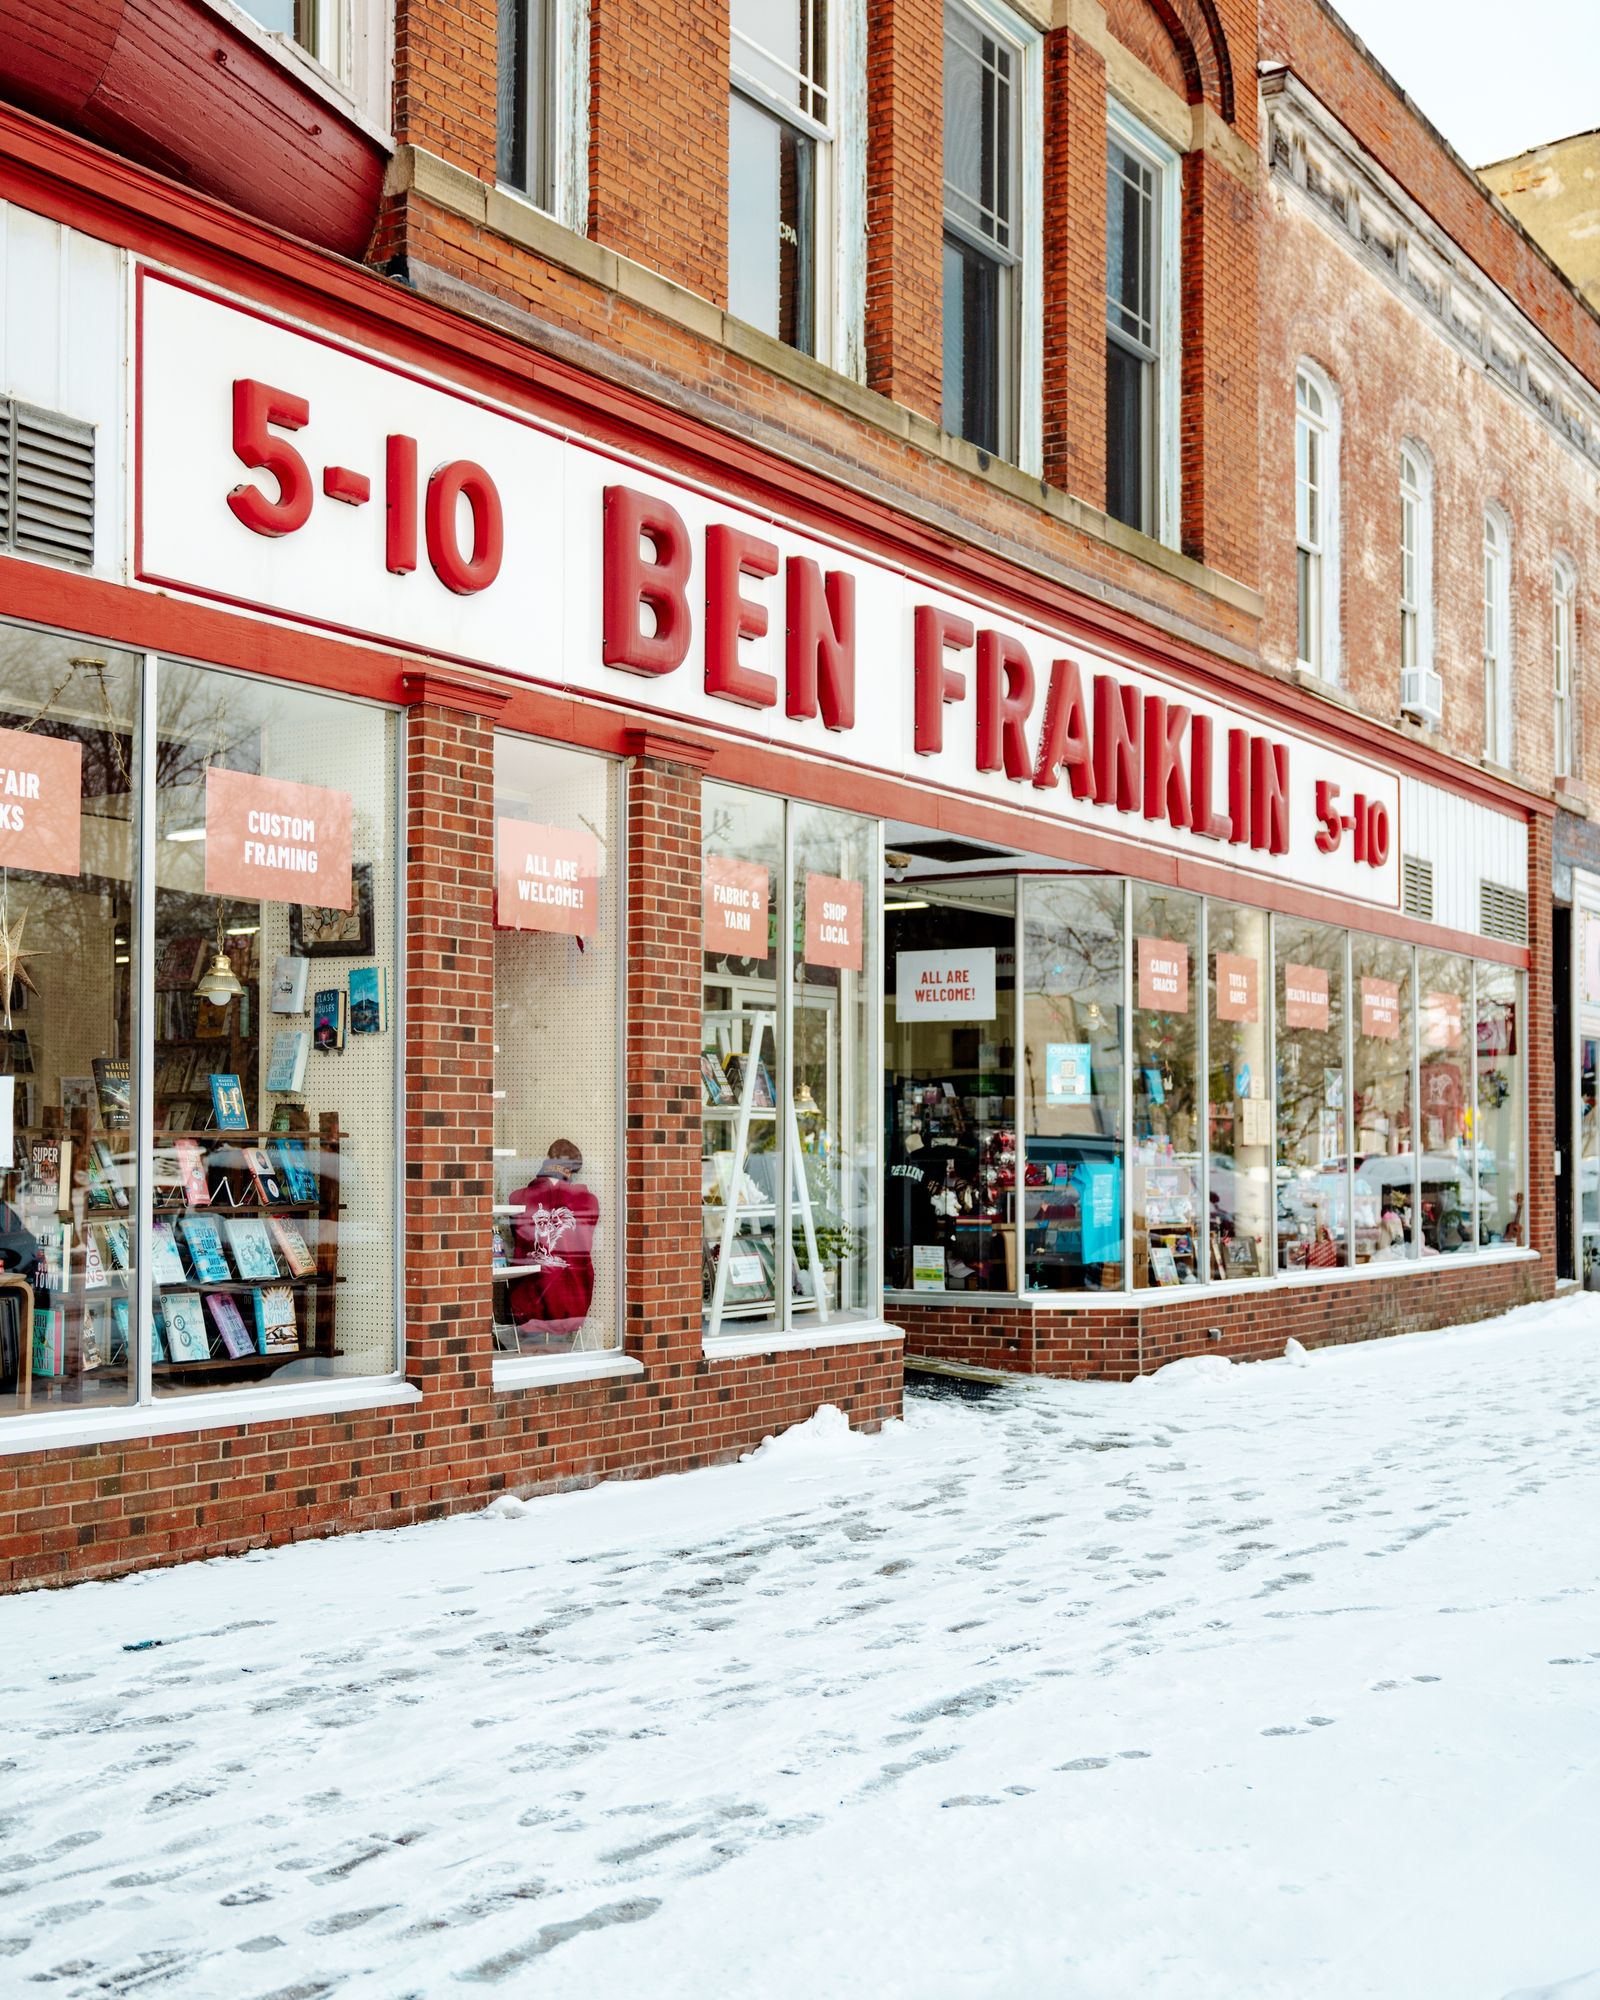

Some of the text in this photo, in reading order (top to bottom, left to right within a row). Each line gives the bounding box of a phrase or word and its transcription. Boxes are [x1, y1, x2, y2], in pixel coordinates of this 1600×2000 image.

[779, 221, 798, 247] CPA
[227, 378, 1390, 869] 5-10 BEN FRANKLIN 5-10
[248, 810, 315, 843] CUSTOM
[244, 840, 318, 873] FRAMING
[525, 853, 578, 882] ALL ARE
[517, 879, 584, 909] WELCOME!
[713, 884, 760, 910] FABRIC &
[724, 910, 751, 932] YARN
[823, 902, 848, 922] SHOP
[820, 924, 849, 945] LOCAL
[921, 970, 969, 984] ALL ARE
[1151, 959, 1179, 976] CANDY &
[1152, 977, 1178, 993] SNACKS
[1229, 973, 1242, 988] TOYS
[915, 988, 976, 1003] WELCOME!
[1230, 990, 1247, 1005] GAMES
[110, 1062, 129, 1070] GALES
[33, 1147, 58, 1163] SUPER
[32, 1184, 57, 1196] TIM BLAKE
[35, 1272, 59, 1291] TOWN
[268, 1299, 289, 1312] PAIR
